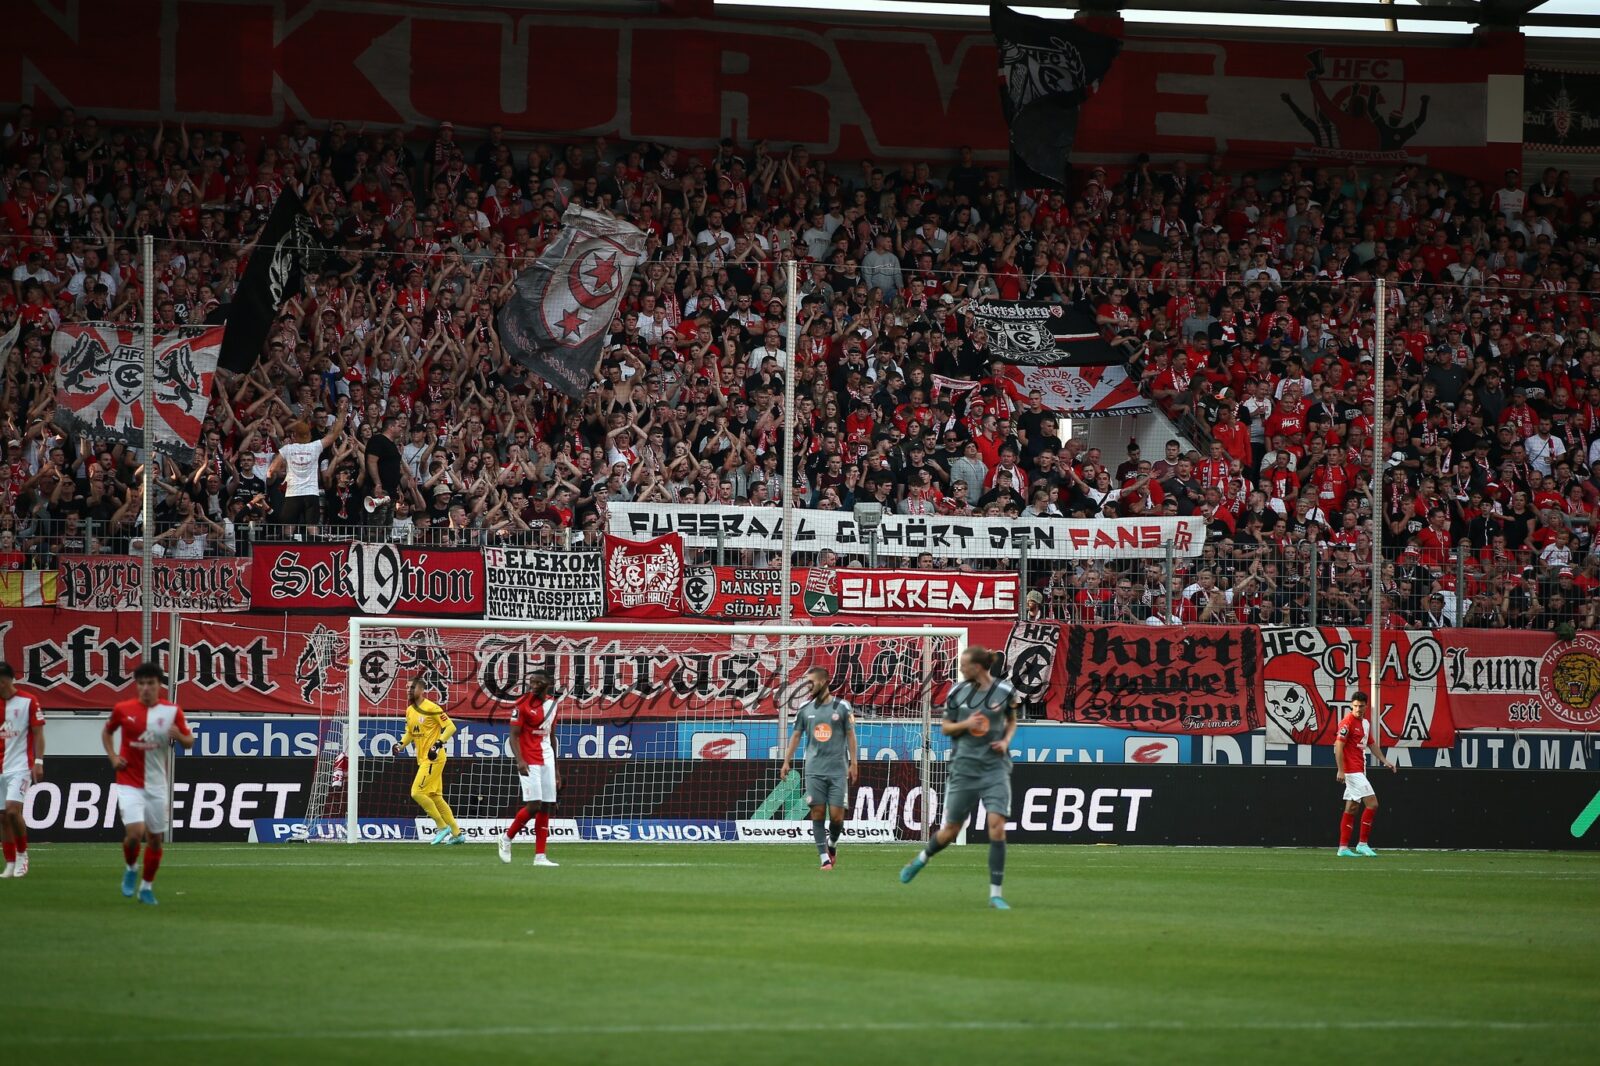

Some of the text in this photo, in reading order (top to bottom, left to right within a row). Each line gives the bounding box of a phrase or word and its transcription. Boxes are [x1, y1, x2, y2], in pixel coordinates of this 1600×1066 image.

[1332, 59, 1390, 79] HFC
[1108, 407, 1152, 418] SIEGEN
[628, 512, 1162, 551] FUSSBALL GHÖRT DEN FANS
[486, 548, 601, 573] TELEKOM
[487, 568, 601, 589] BOYKOTTIEREN
[720, 580, 801, 595] MANSFED
[488, 586, 602, 606] MONTAGSSPIELE
[842, 578, 1016, 611] SURREALE
[489, 601, 603, 621] NICHT AKZEPTIEREN
[1260, 630, 1316, 658] HFC
[1545, 637, 1600, 665] HALLESCH
[1445, 647, 1539, 692] Leuna
[1508, 699, 1543, 723] seit
[272, 823, 302, 839] PS
[421, 826, 484, 839] beegt
[595, 825, 722, 841] PS UNION
[742, 826, 803, 840] bewegt
